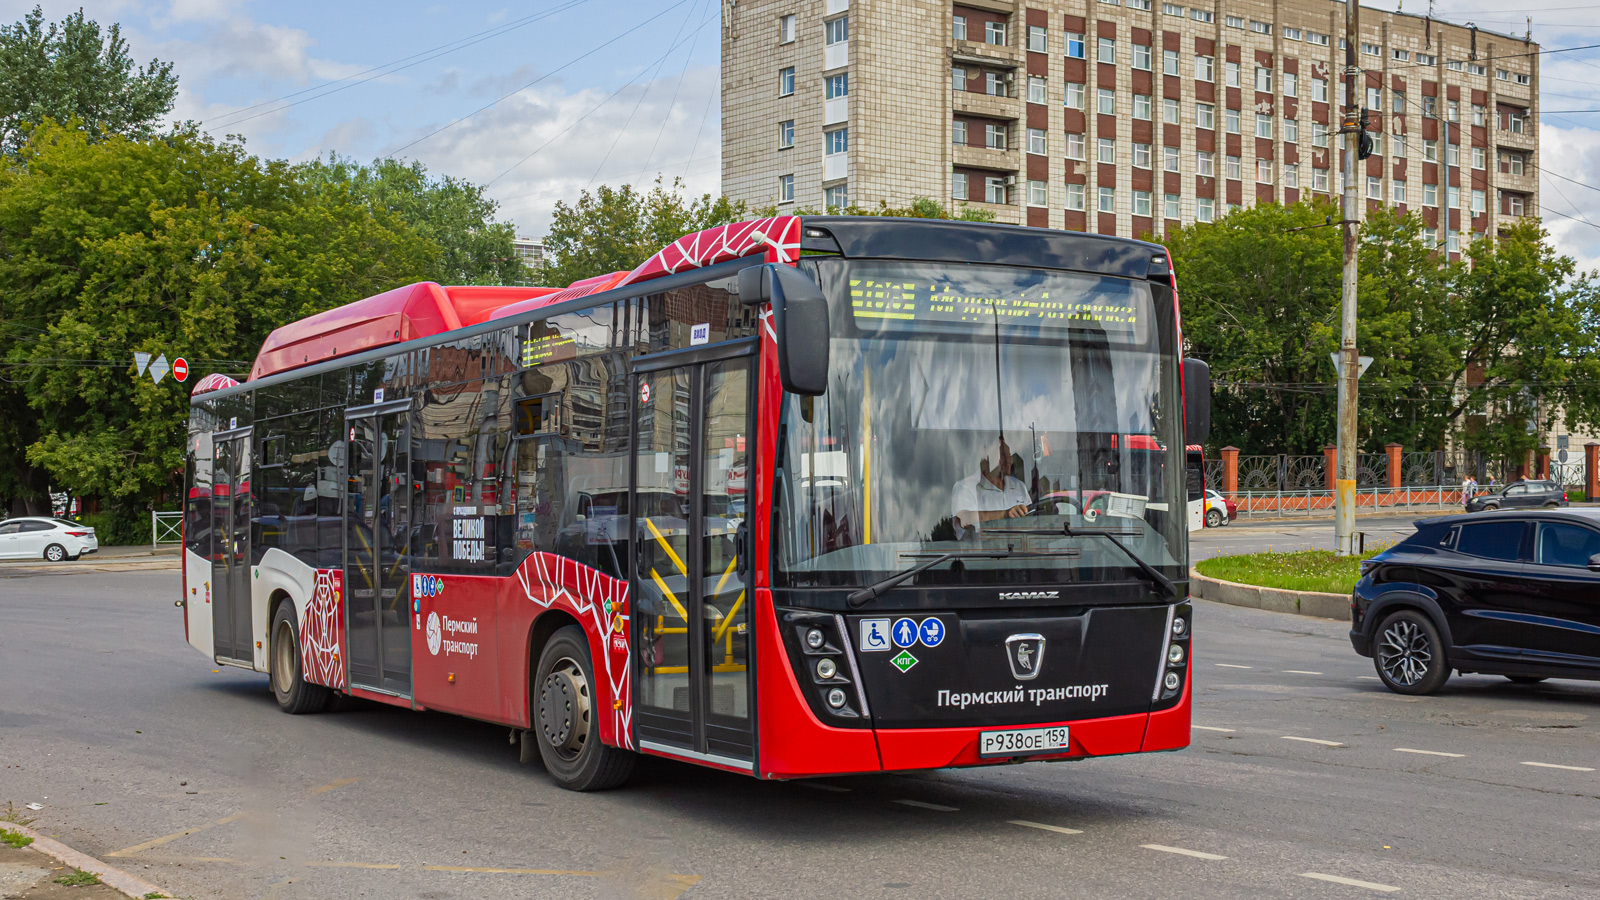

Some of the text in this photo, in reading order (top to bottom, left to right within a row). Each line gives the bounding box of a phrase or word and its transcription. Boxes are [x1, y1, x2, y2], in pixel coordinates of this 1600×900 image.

[453, 516, 485, 539] ВЕЛИКОЙ
[453, 540, 485, 563] ПОБЕДЫ!
[999, 591, 1060, 600] KAMAZ
[442, 615, 478, 637] Пермский
[442, 640, 478, 660] транспорт
[897, 656, 913, 666] КПГ
[937, 684, 1109, 709] Пермский транспорт
[1045, 729, 1066, 743] 159
